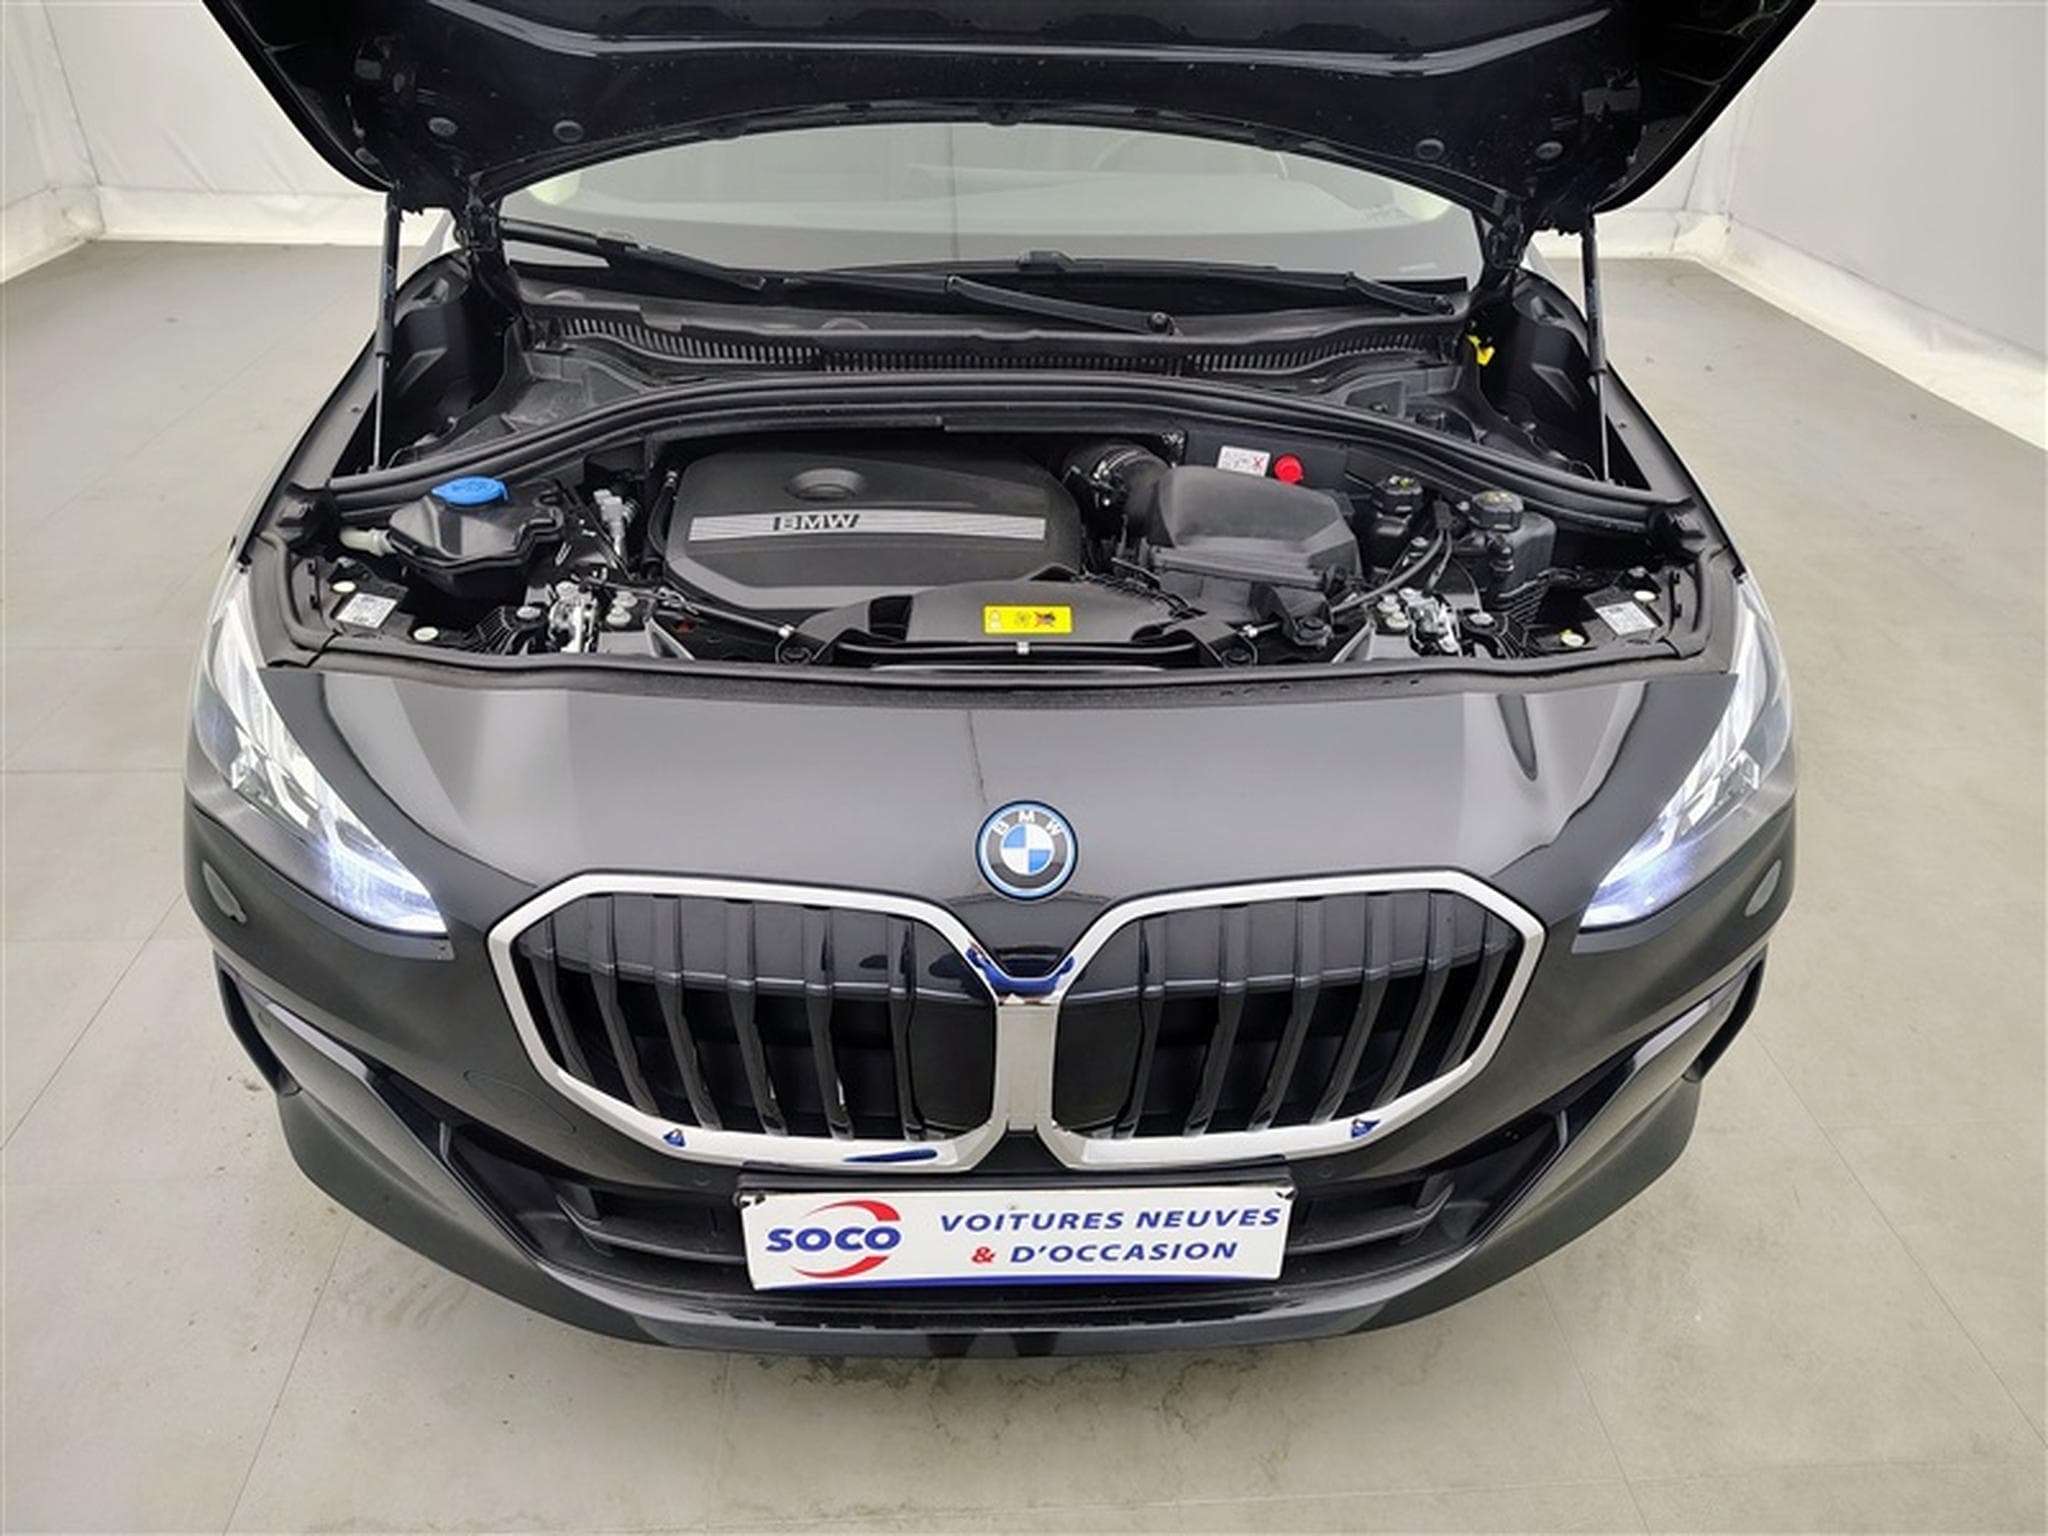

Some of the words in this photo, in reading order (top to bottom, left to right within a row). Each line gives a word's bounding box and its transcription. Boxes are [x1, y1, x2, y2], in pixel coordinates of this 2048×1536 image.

[772, 512, 860, 532] BMW
[990, 810, 1062, 836] BMW
[940, 1212, 1125, 1232] VOITURES
[1135, 1207, 1282, 1230] NEUVES
[765, 1226, 902, 1253] SOCO
[970, 1246, 997, 1265] &
[1010, 1242, 1238, 1264] D'OCCASION
